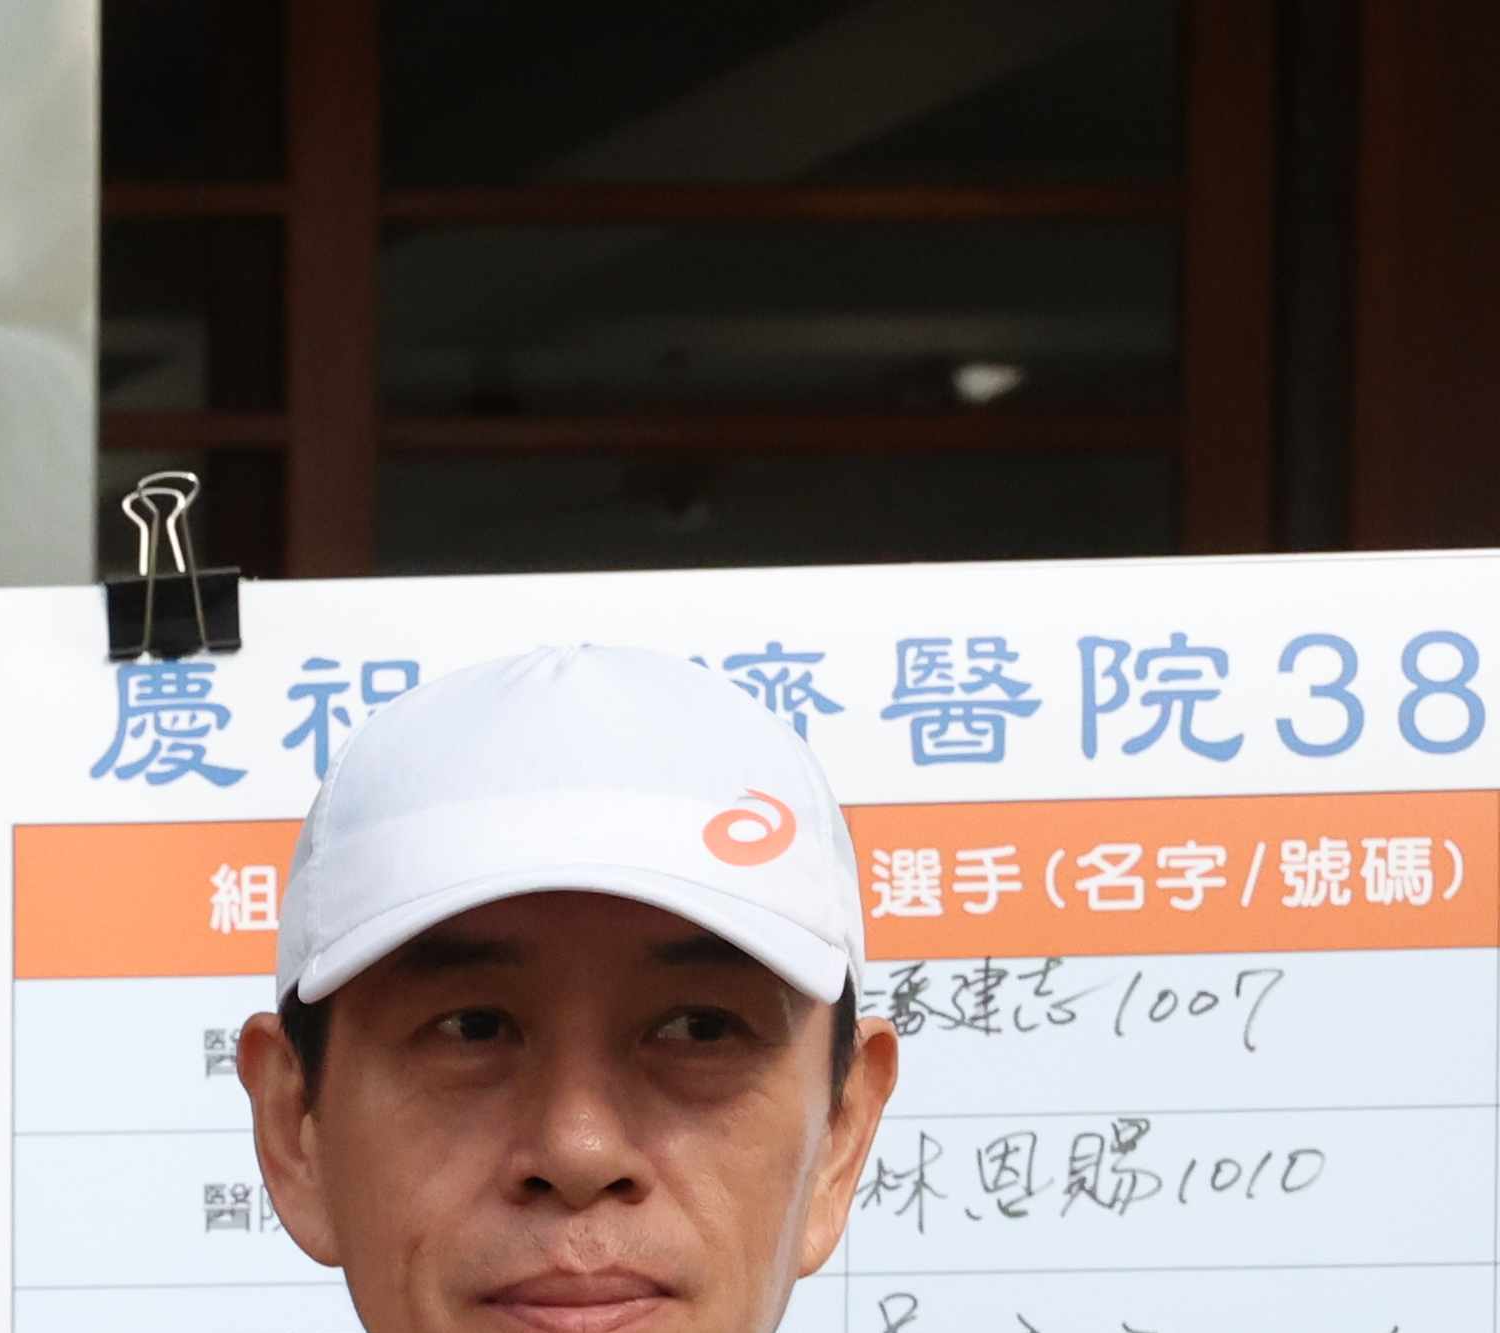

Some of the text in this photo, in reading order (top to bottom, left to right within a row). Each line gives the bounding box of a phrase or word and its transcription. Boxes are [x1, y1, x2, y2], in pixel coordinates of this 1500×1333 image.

[88, 622, 1487, 788] 慶祝濟醫院38
[869, 836, 1466, 920] 選手(名字/號碼)
[1112, 967, 1284, 1053] 1007
[1177, 1147, 1325, 1206] 1010
